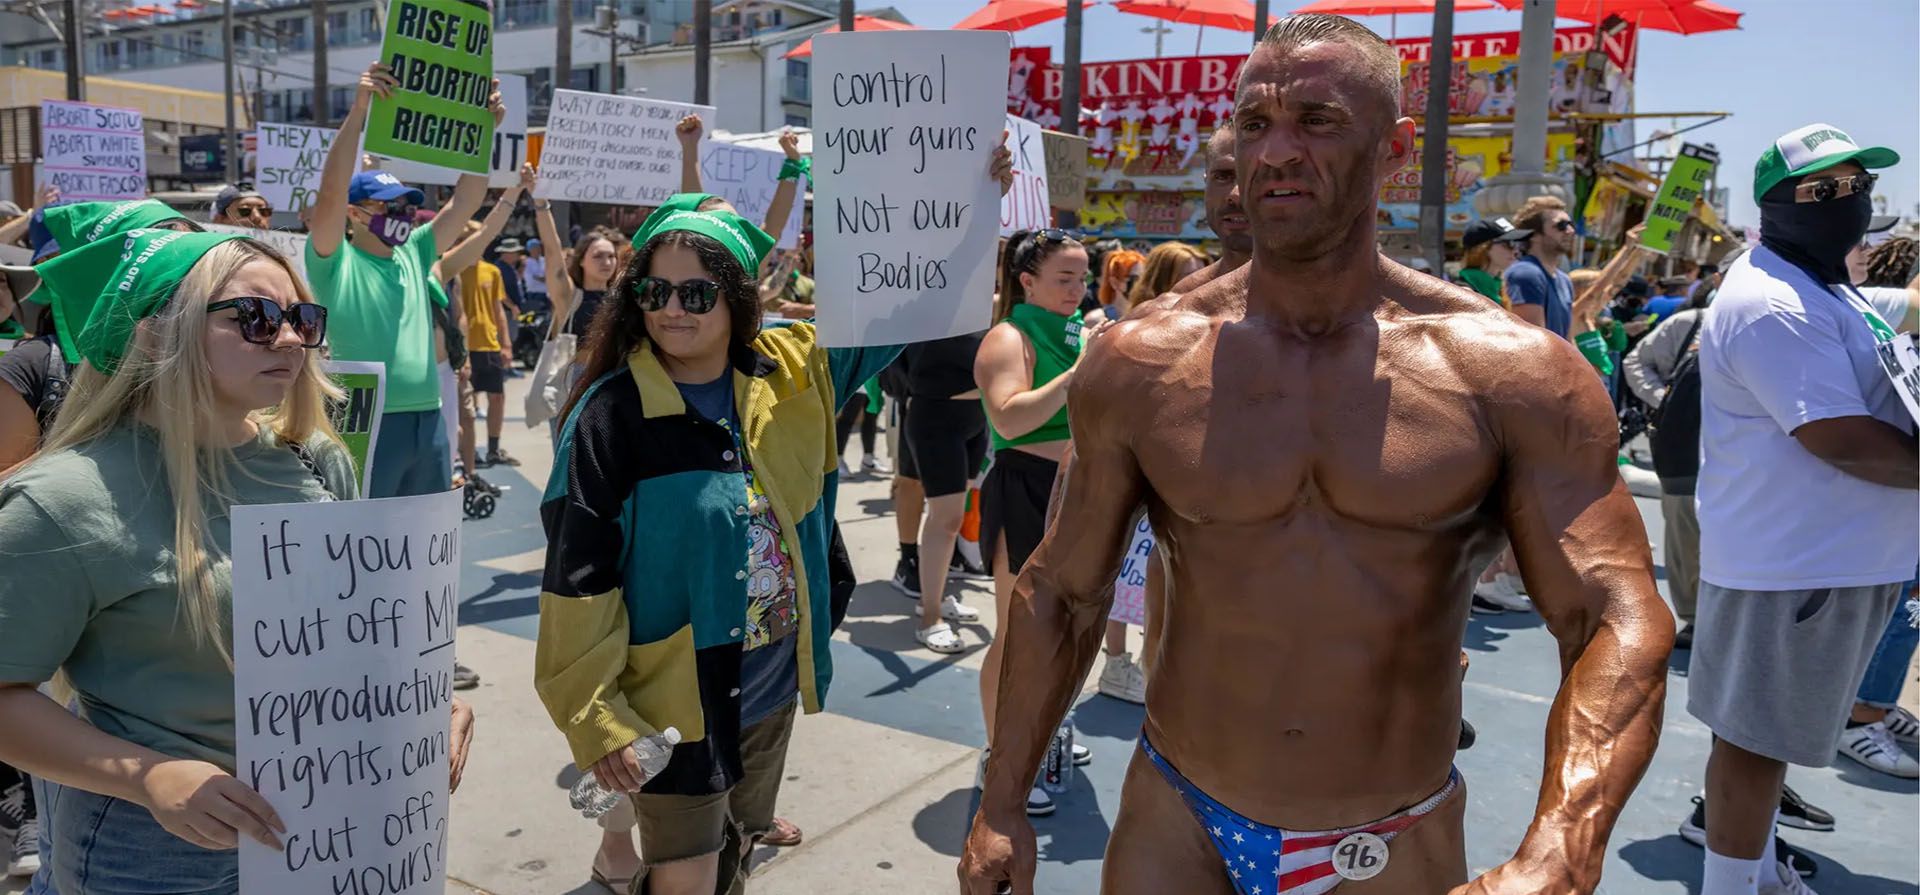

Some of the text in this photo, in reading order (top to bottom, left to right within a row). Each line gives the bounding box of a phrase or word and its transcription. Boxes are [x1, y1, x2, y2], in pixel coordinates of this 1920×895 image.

[396, 3, 489, 57] RISE UP
[833, 54, 946, 109] control
[1043, 60, 1187, 101] BKINI
[47, 104, 90, 128] ABORT
[392, 107, 482, 156] RIGHTS!
[551, 116, 670, 141] PREDATORY MEN
[47, 134, 140, 157] ABORT WHITE
[261, 126, 311, 149] THEY
[825, 126, 977, 175] your guns
[261, 167, 314, 186] STOP
[702, 146, 758, 183] KEEP
[564, 183, 599, 200] GO
[913, 199, 971, 231] our
[857, 251, 948, 293] Bodies
[260, 519, 457, 600] if you can
[254, 583, 456, 658] cut off MY
[248, 667, 450, 745] reproductive
[250, 731, 445, 810] rights, can
[286, 790, 434, 873] cut off
[332, 817, 446, 895] yours?
[1338, 843, 1378, 870] 96
